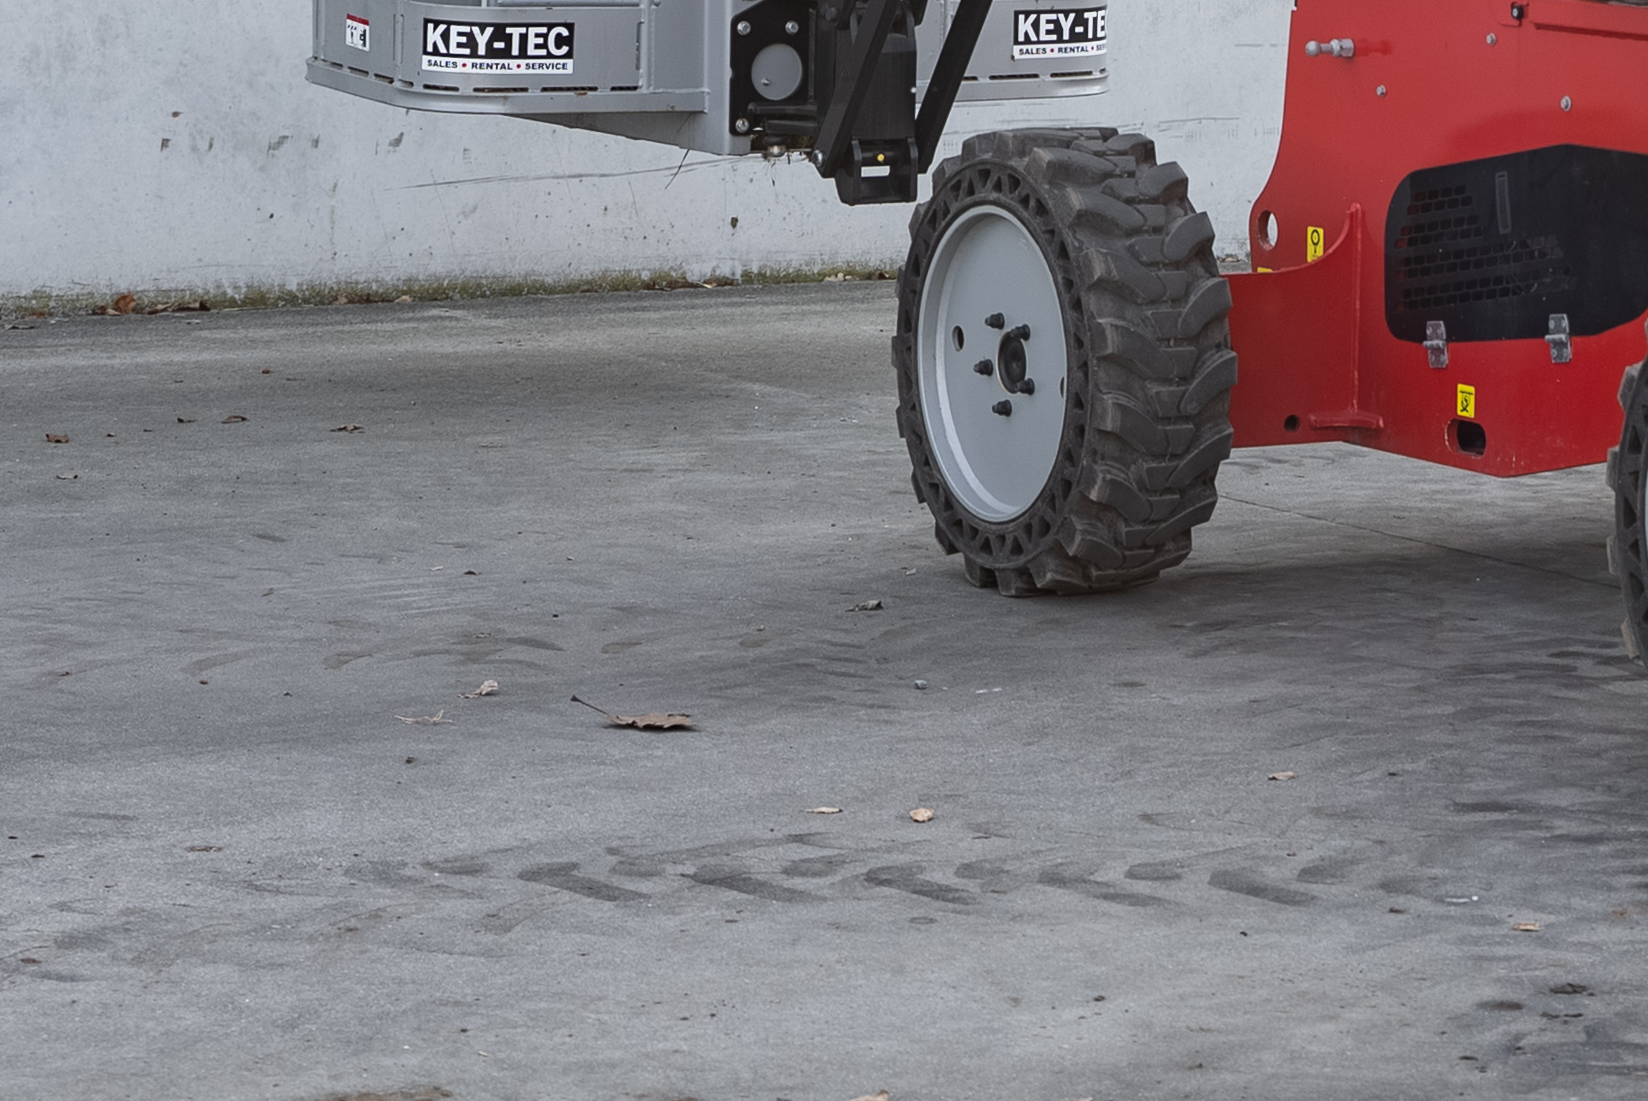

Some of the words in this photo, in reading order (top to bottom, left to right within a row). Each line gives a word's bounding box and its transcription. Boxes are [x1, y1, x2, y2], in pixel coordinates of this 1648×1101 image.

[1018, 10, 1106, 42] KEY-TE
[426, 23, 570, 56] KEY-TEC
[1019, 48, 1047, 56] SALES
[1057, 45, 1089, 54] RENTAL
[427, 59, 458, 69] SALES
[471, 62, 513, 71] RENTAL
[525, 62, 568, 71] SERVICE
